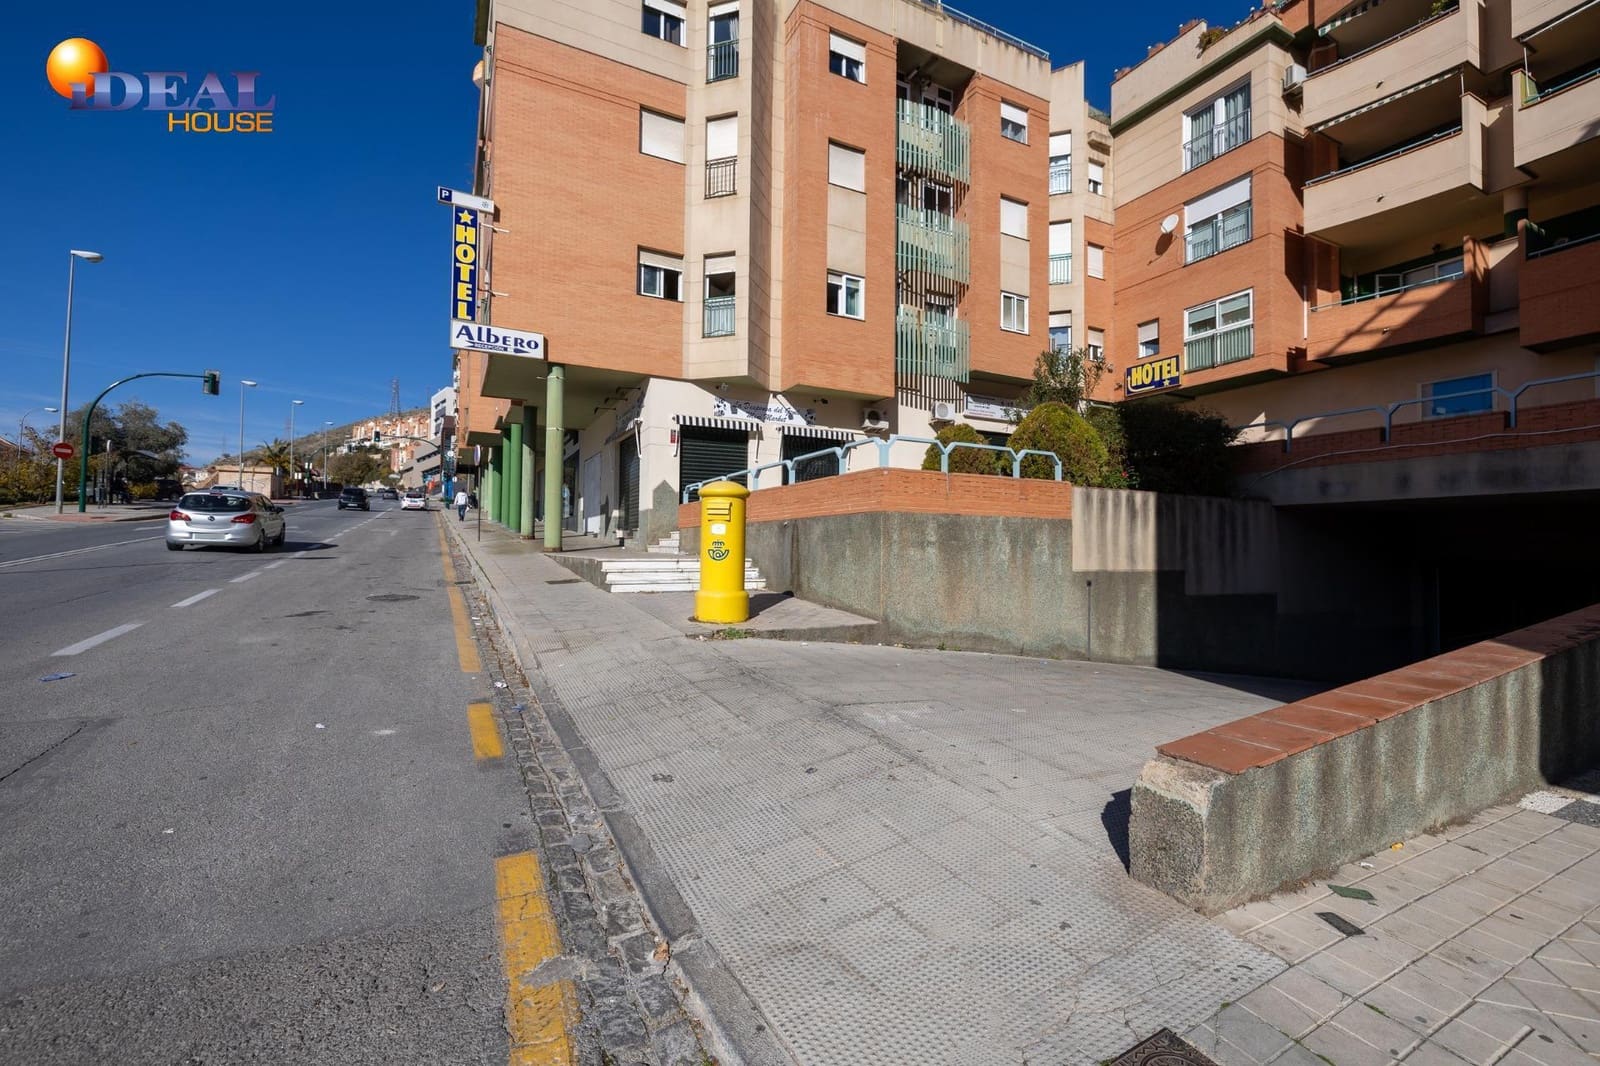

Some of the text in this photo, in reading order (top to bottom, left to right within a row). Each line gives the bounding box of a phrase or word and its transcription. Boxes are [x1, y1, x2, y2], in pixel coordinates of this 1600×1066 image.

[441, 190, 450, 199] P
[455, 224, 476, 320] HOTEL
[1131, 357, 1179, 387] HOTEL
